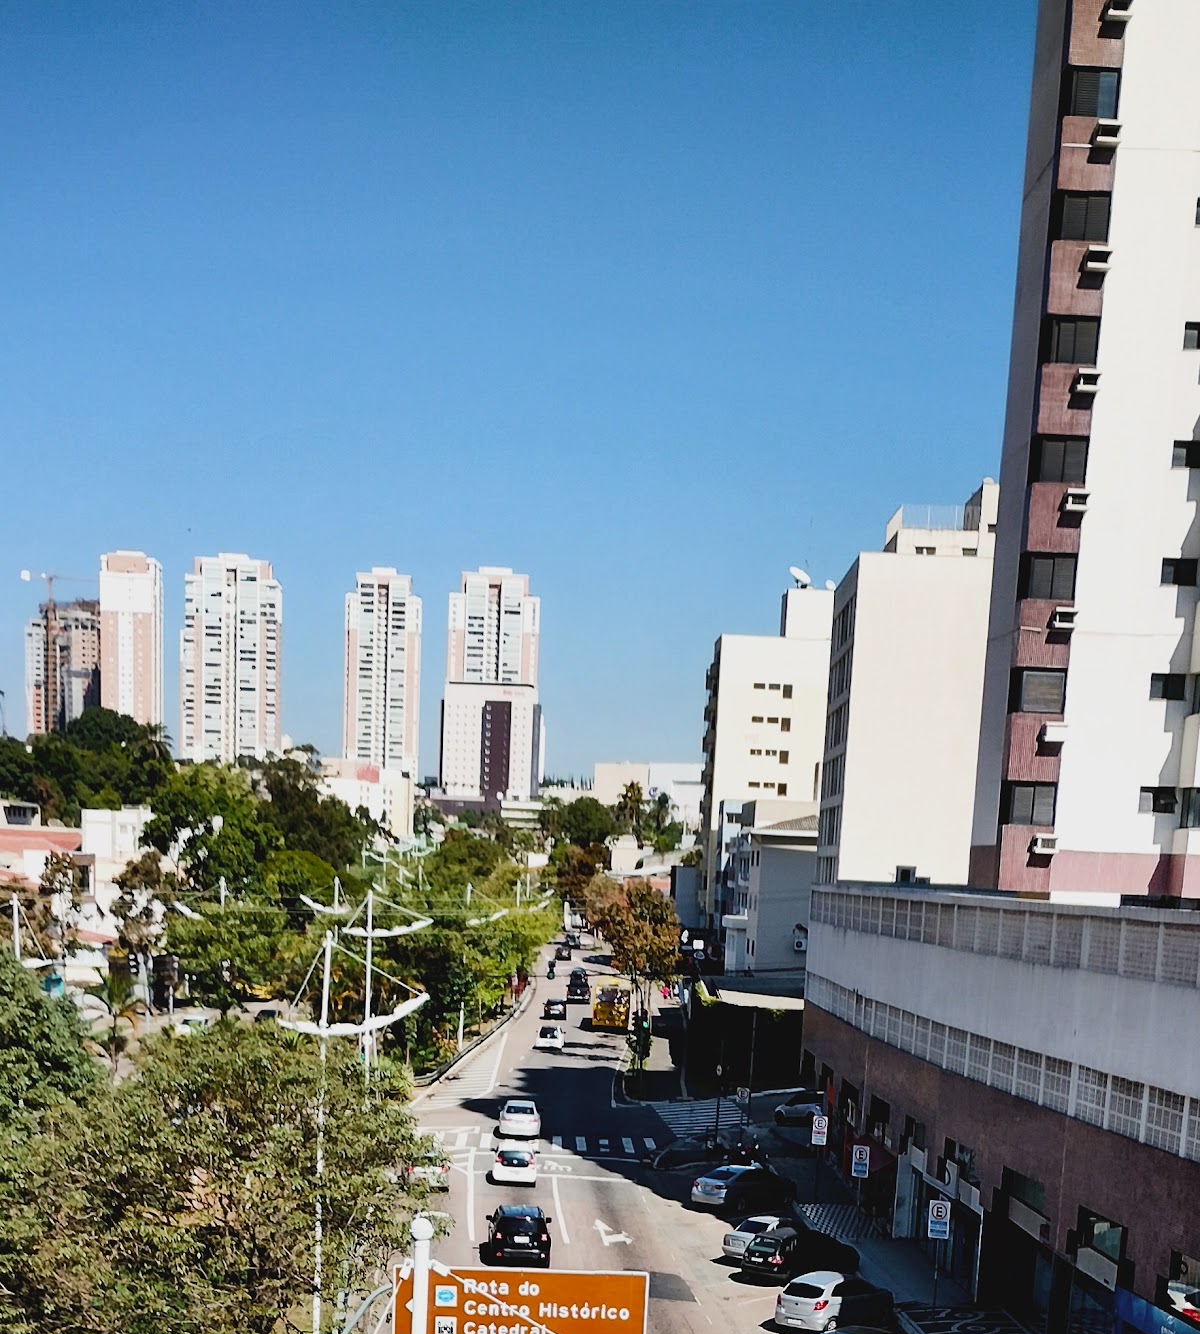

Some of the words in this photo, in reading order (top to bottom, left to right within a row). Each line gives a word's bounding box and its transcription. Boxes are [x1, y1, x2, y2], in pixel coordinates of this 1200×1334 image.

[817, 1120, 823, 1128] E
[858, 1150, 864, 1160] E
[936, 1206, 943, 1218] E
[463, 1278, 509, 1296] Rota
[518, 1280, 541, 1297] do
[463, 1299, 531, 1318] Centro
[538, 1302, 631, 1321] Histórico
